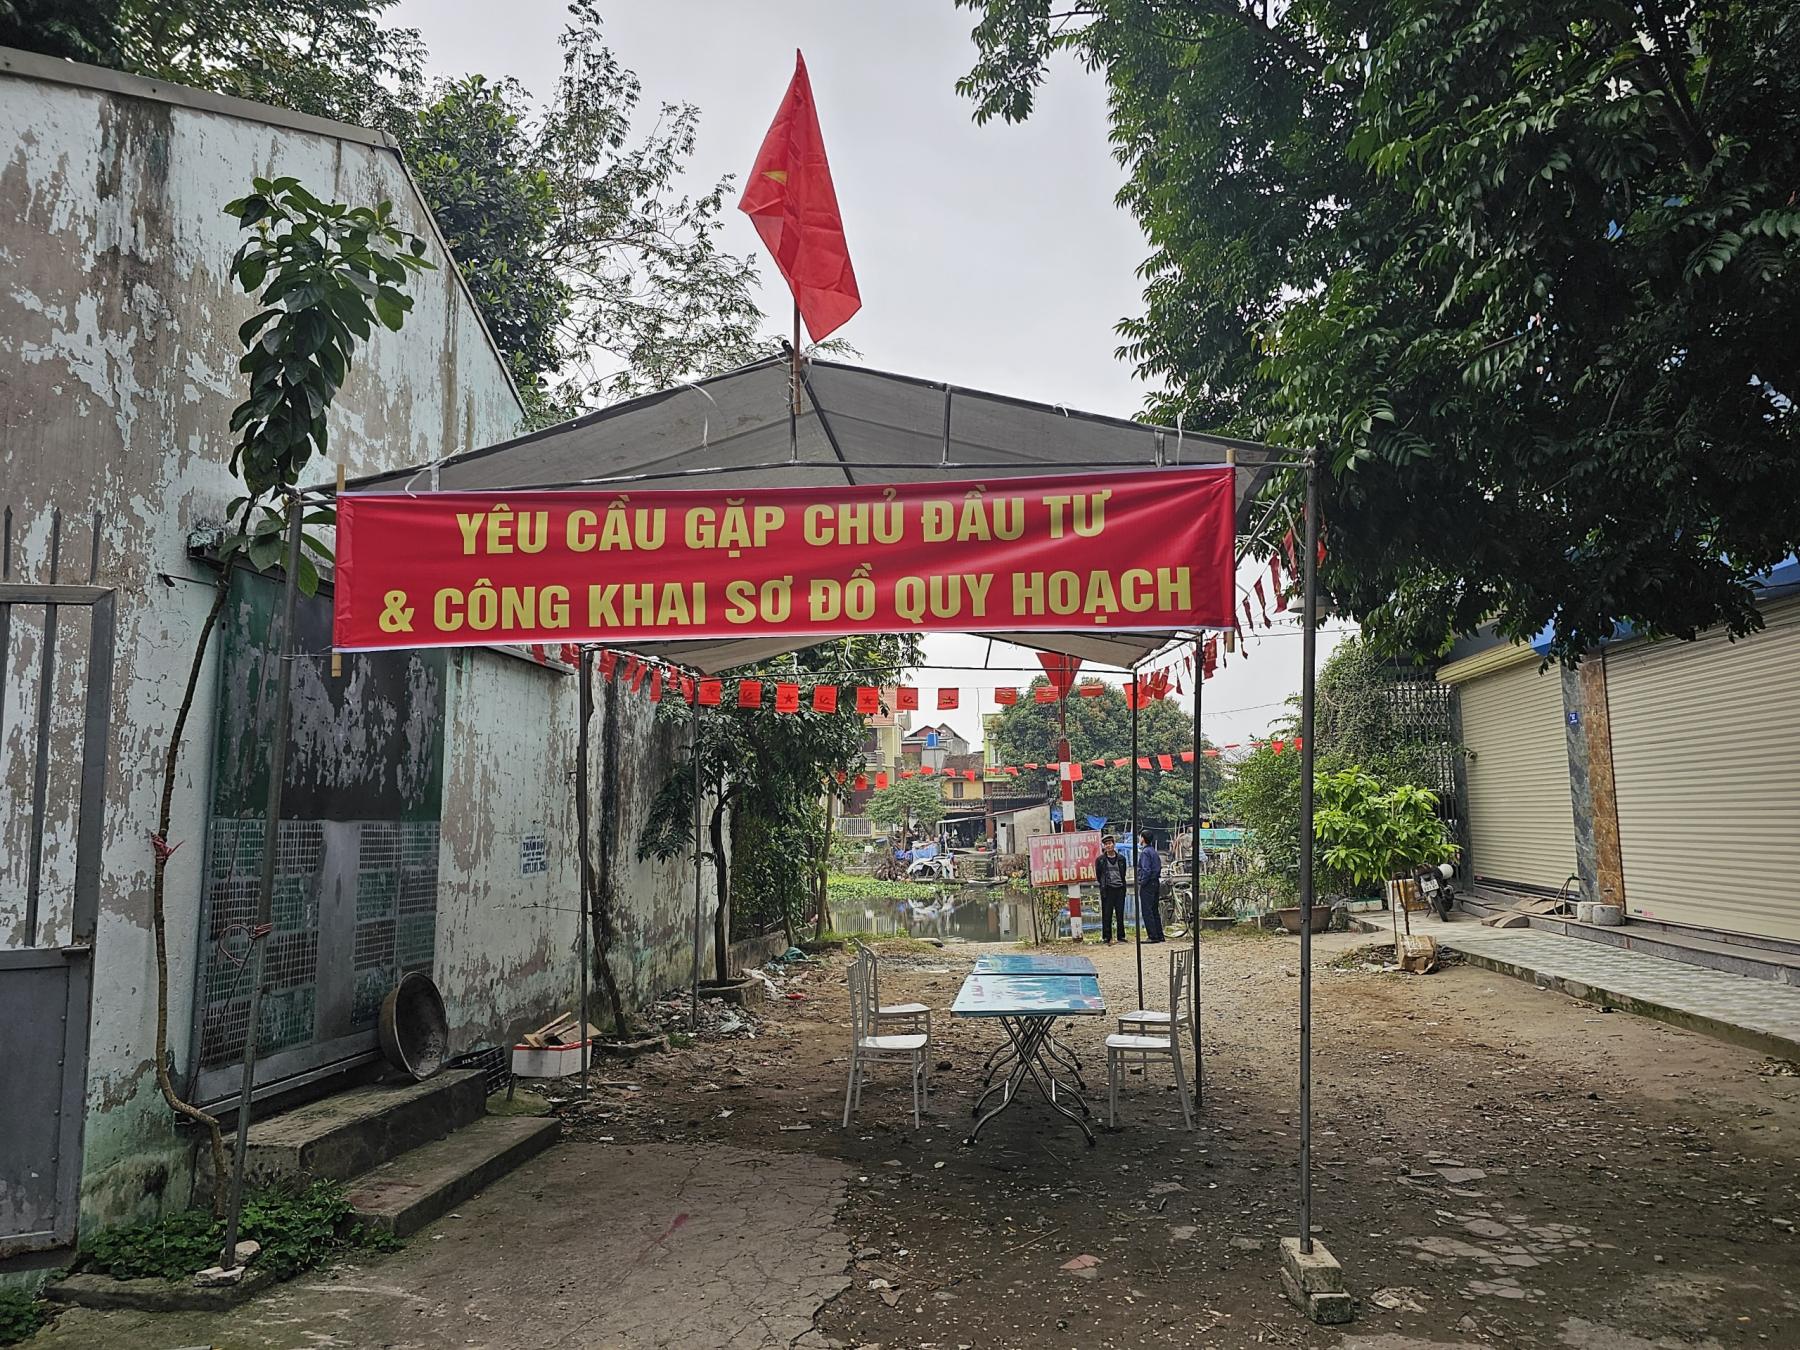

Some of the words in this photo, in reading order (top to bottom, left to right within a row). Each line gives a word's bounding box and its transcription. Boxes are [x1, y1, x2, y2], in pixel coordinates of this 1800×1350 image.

[456, 503, 548, 555] YÊU
[566, 494, 667, 553] CẦU
[684, 497, 786, 558] GẶP
[803, 487, 904, 546] CHỦ
[920, 484, 1025, 543] ĐẦU
[1043, 489, 1112, 539] TƯ
[378, 590, 414, 633] &
[433, 578, 570, 631] CÔNG
[588, 582, 706, 628] KHAI
[725, 575, 793, 624] SƠ
[808, 562, 877, 622] ĐỒ
[895, 573, 994, 624] QUY
[1012, 566, 1193, 624] HOẠCH
[1034, 864, 1060, 884] CẤM
[1080, 862, 1097, 880] RÁ
[1042, 847, 1065, 863] KHU
